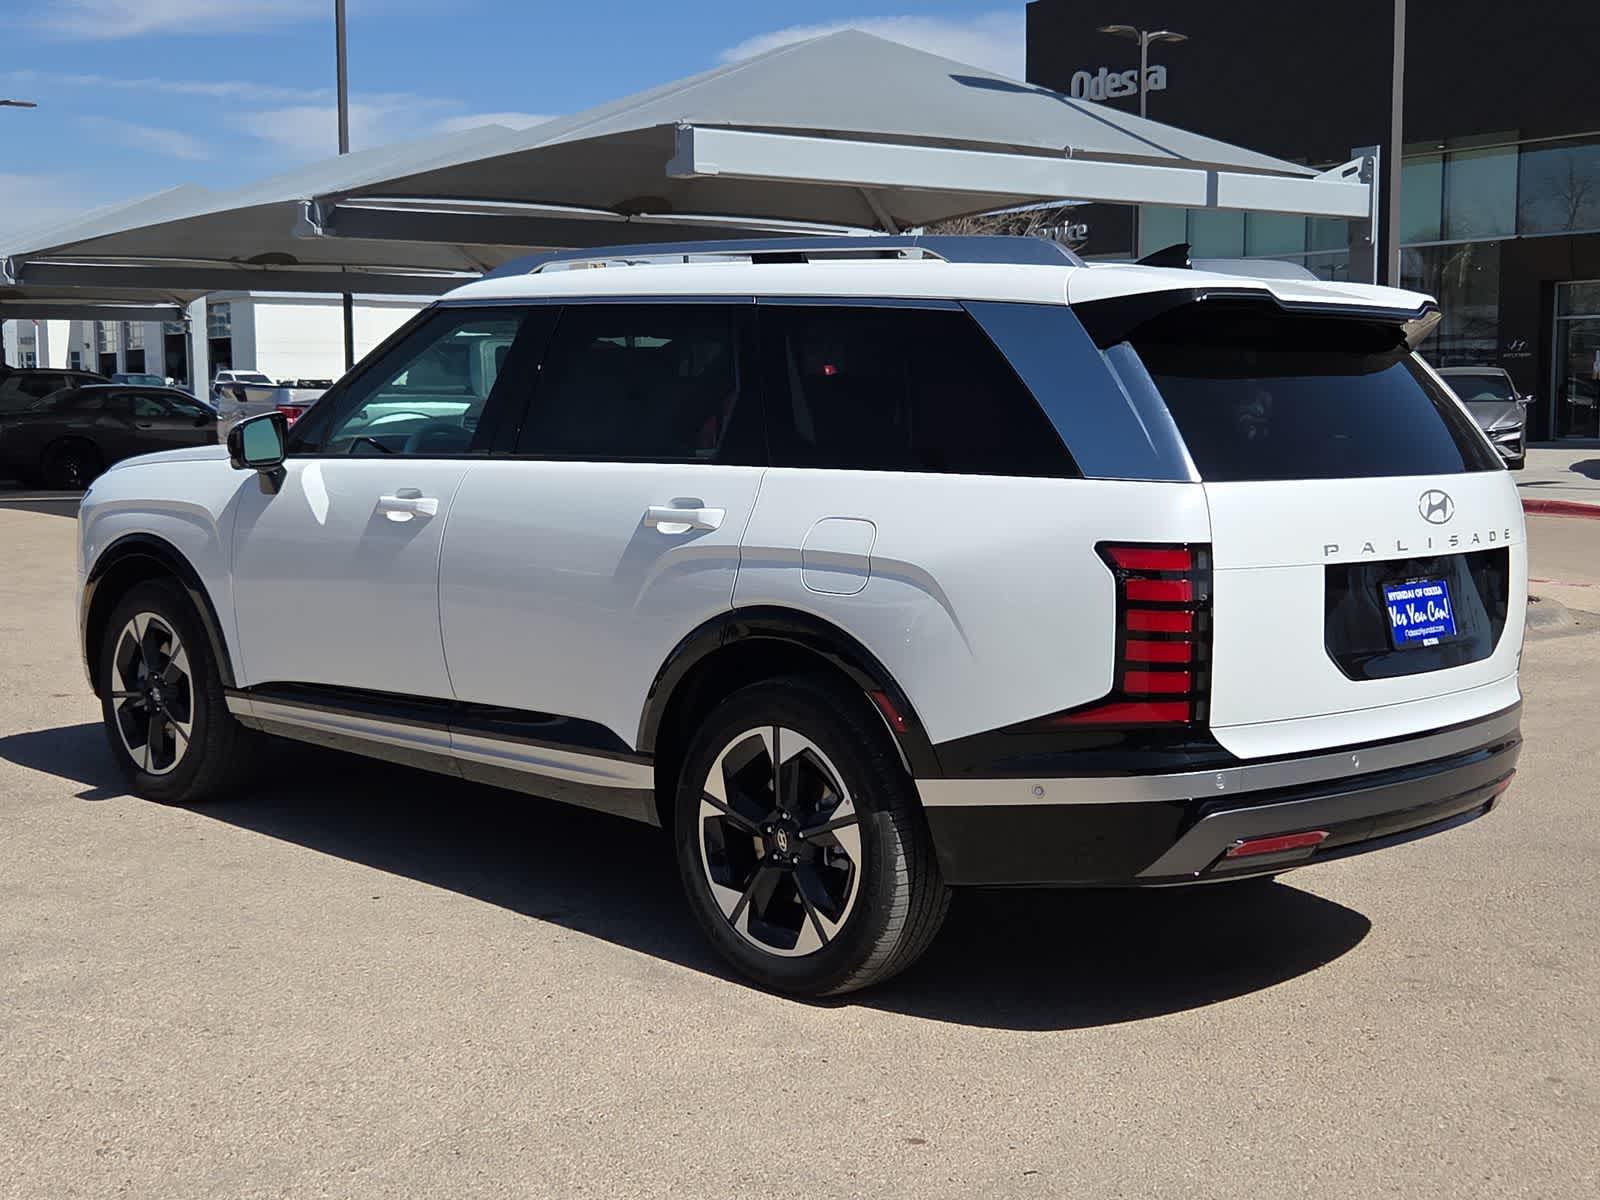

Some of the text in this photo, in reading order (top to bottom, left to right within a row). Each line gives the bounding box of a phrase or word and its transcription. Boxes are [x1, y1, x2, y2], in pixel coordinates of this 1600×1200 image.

[1070, 64, 1167, 101] Odesa
[1323, 528, 1511, 557] PALISADE
[1388, 597, 1450, 628] Yes You Can!
